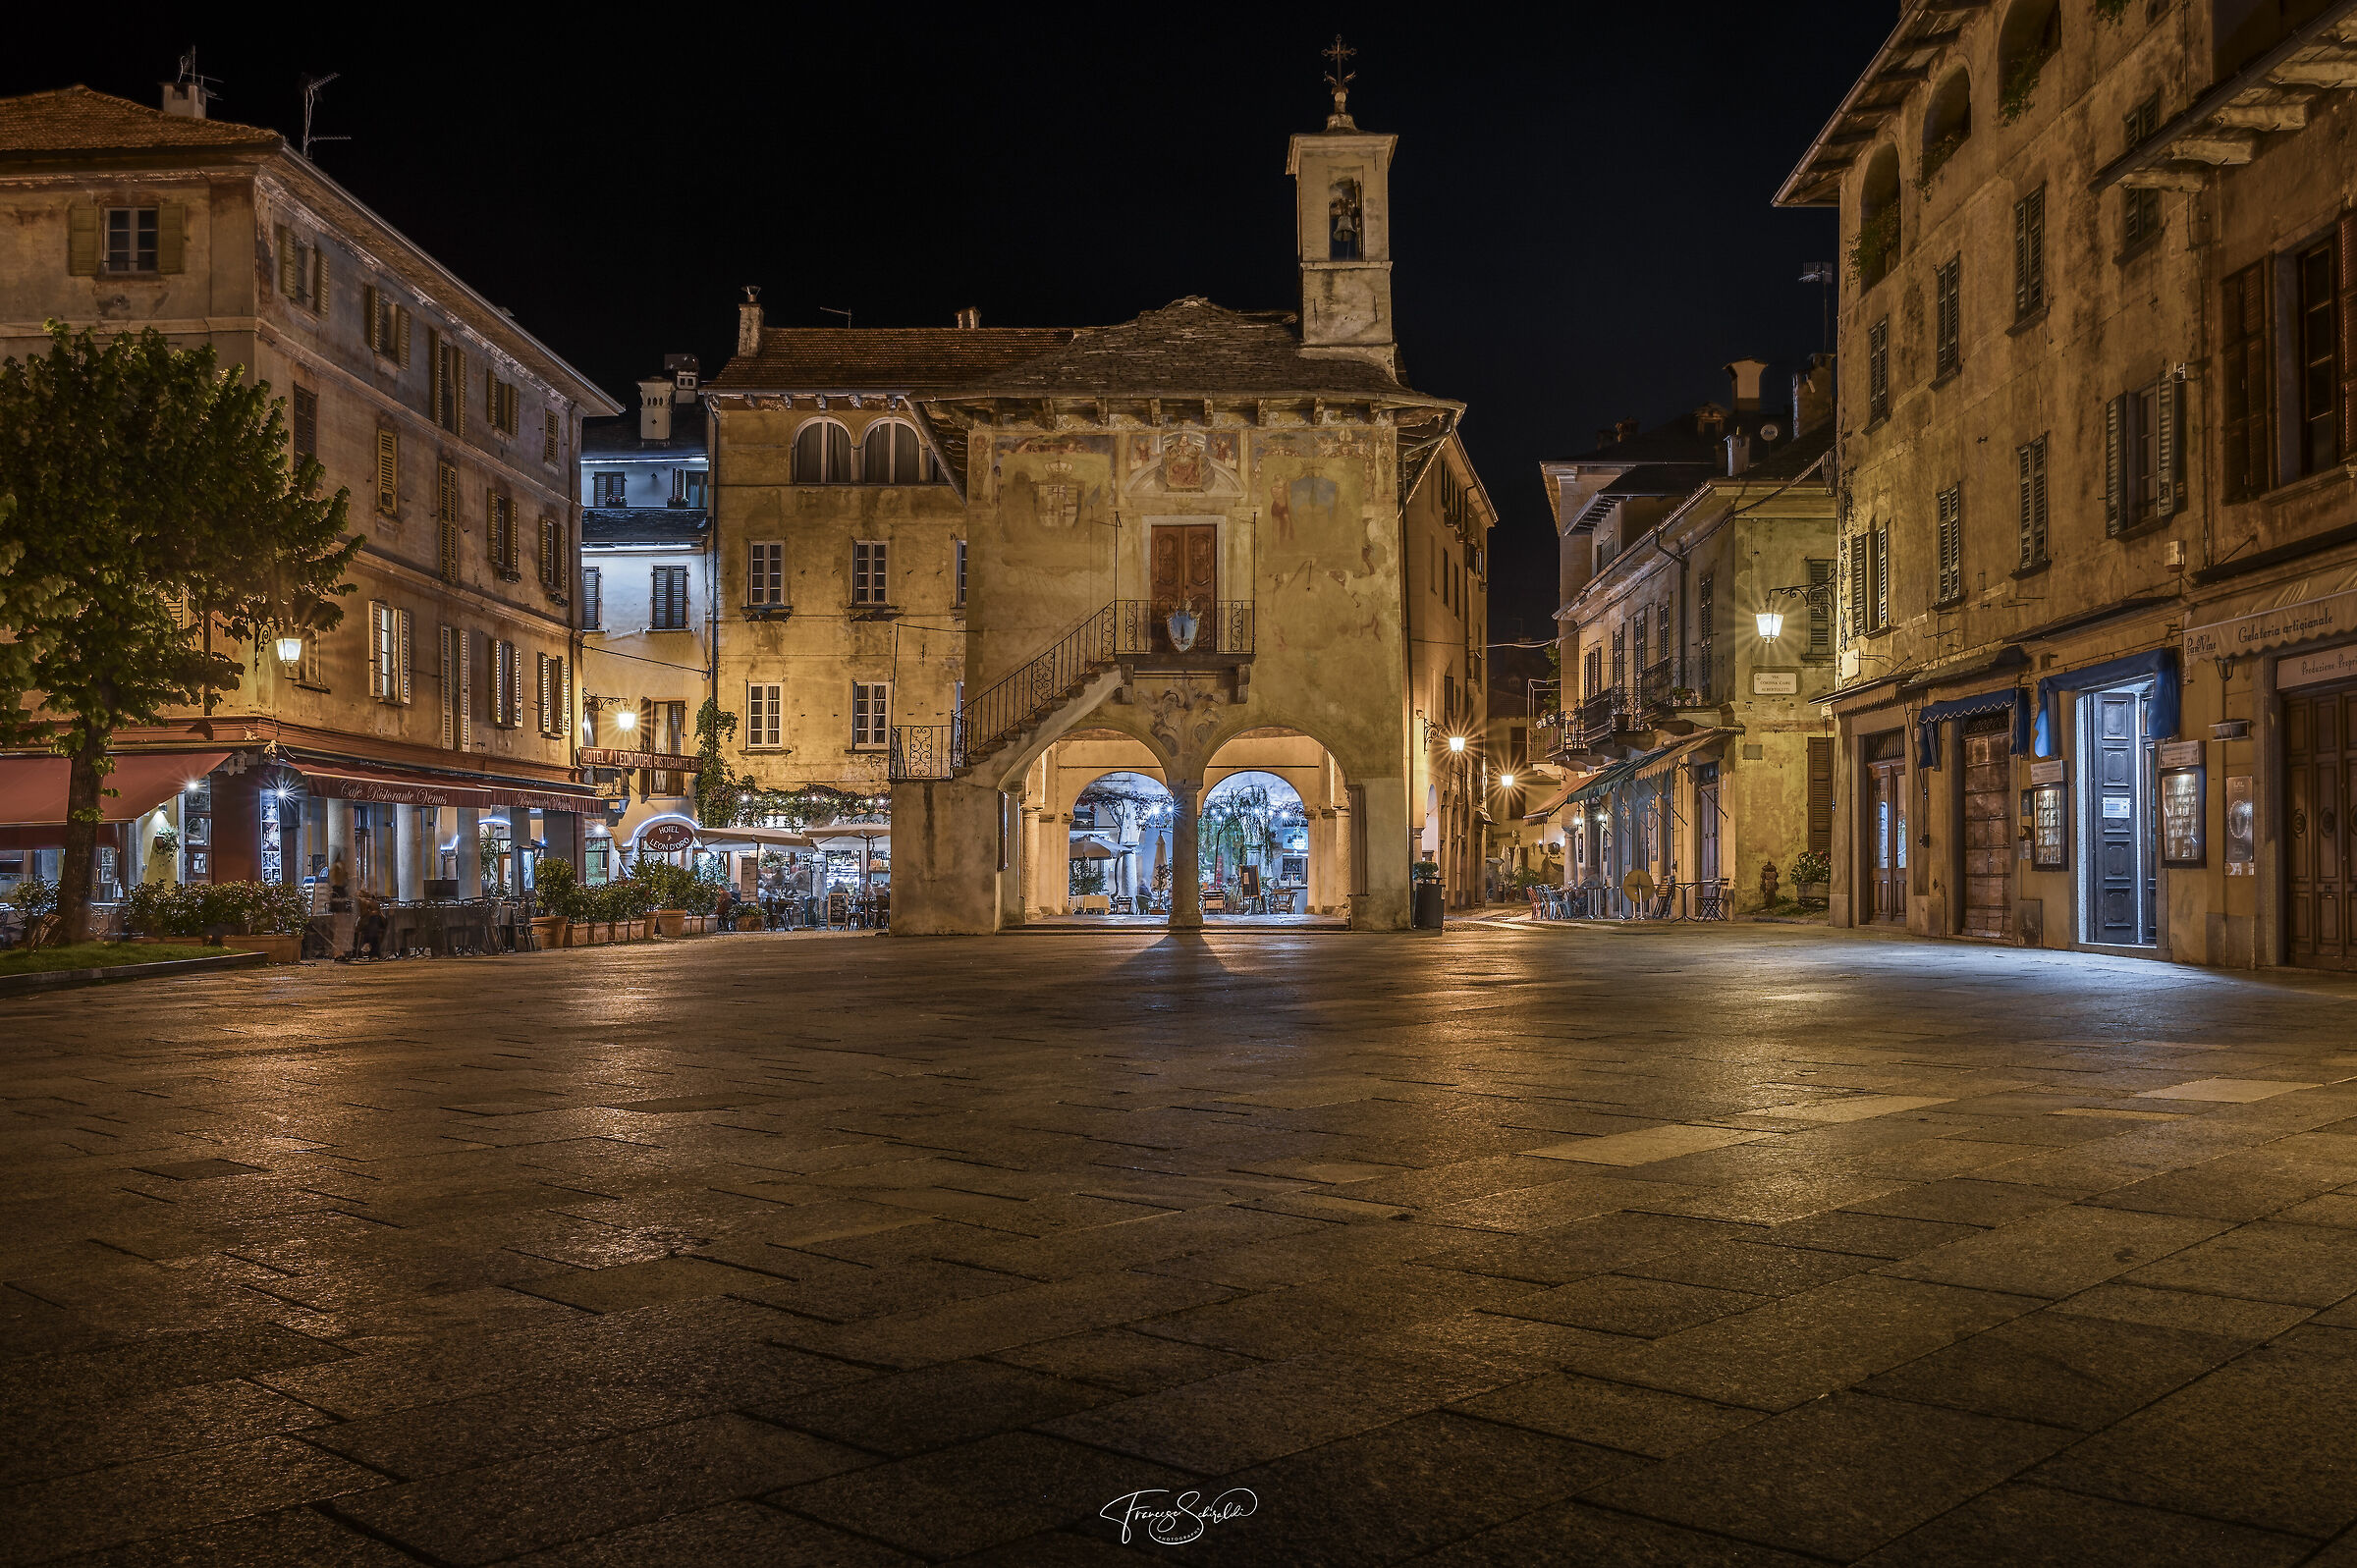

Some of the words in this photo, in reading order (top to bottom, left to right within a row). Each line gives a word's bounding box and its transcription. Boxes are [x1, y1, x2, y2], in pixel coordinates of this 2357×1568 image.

[2238, 623, 2280, 644] Gelateria
[2283, 607, 2333, 636] artigianale
[2302, 659, 2334, 676] Produzione
[582, 749, 606, 764] HOTEL
[653, 755, 689, 771] RISTORANTE
[690, 758, 703, 773] BAR
[367, 784, 414, 802] Ristorante
[659, 825, 680, 835] HOTEL
[649, 838, 669, 851] LEON
